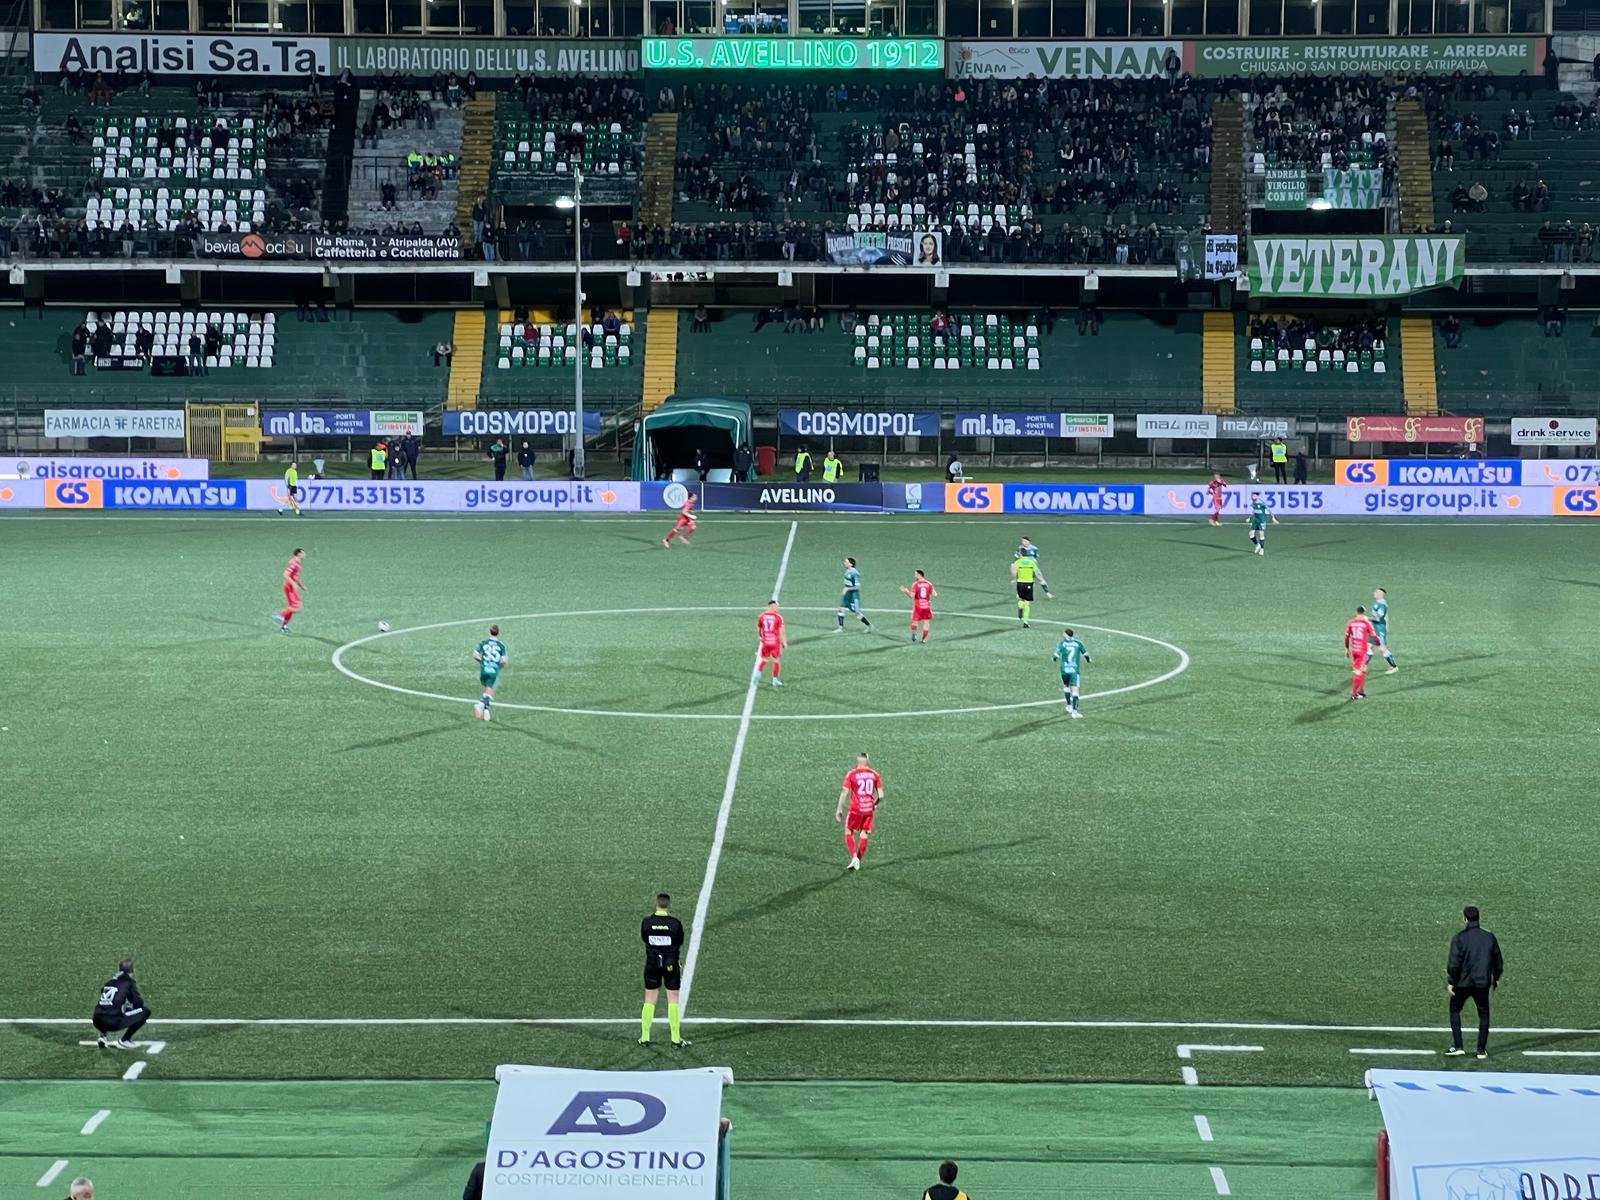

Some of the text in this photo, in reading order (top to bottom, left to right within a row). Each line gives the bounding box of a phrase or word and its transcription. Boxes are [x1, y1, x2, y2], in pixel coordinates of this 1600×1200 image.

[59, 37, 327, 73] Analisi Sa.Ta.
[337, 46, 352, 69] IL
[356, 47, 470, 70] LABORATORIO
[556, 48, 638, 72] AVELLINO
[646, 40, 939, 68] U.S. AVELLINO 1912
[1036, 46, 1174, 75] VENAM
[1203, 46, 1290, 60] COSTRUIRE
[1304, 45, 1430, 59] RISTRUTTURARE
[1443, 44, 1527, 58] ARREDARE
[955, 61, 1007, 74] VENAM
[1240, 59, 1488, 72] CHIUSANO SAN DOMENICO E ATRIPALDA
[1266, 170, 1306, 179] ANDREA E
[1267, 181, 1305, 190] VIRGILIO
[1267, 191, 1304, 201] CON NOI
[316, 237, 333, 247] Via
[336, 238, 368, 248] Roma,
[372, 238, 377, 247] 1
[388, 238, 433, 248] Atripalda
[436, 237, 459, 248] (AV)
[315, 247, 459, 258] Caffetteria e Cocktelleria
[1254, 238, 1461, 295] VETERANI
[46, 417, 111, 431] FARMACIA
[132, 417, 183, 431] FARETRA
[797, 412, 922, 436] COSMOPOL
[1517, 428, 1546, 437] drink
[36, 461, 158, 479] gisgroup.it
[1346, 462, 1513, 484] GS KOMATSU
[1564, 465, 1600, 482] 07
[56, 482, 237, 506] GS KOMATSU
[296, 486, 425, 505] 0771.531513
[465, 484, 594, 508] gisgroup.it
[759, 488, 836, 504] AVELLINO
[957, 486, 1135, 511] GS KOMATSU
[1190, 490, 1324, 510] 071.31513
[1364, 489, 1498, 512] gisgroup.it
[1564, 489, 1599, 512] GS
[1065, 646, 1076, 662] 7
[857, 778, 874, 796] 20
[496, 1149, 706, 1170] D'AGOSTINO
[495, 1172, 704, 1187] COSTRUZIONI GENERALI
